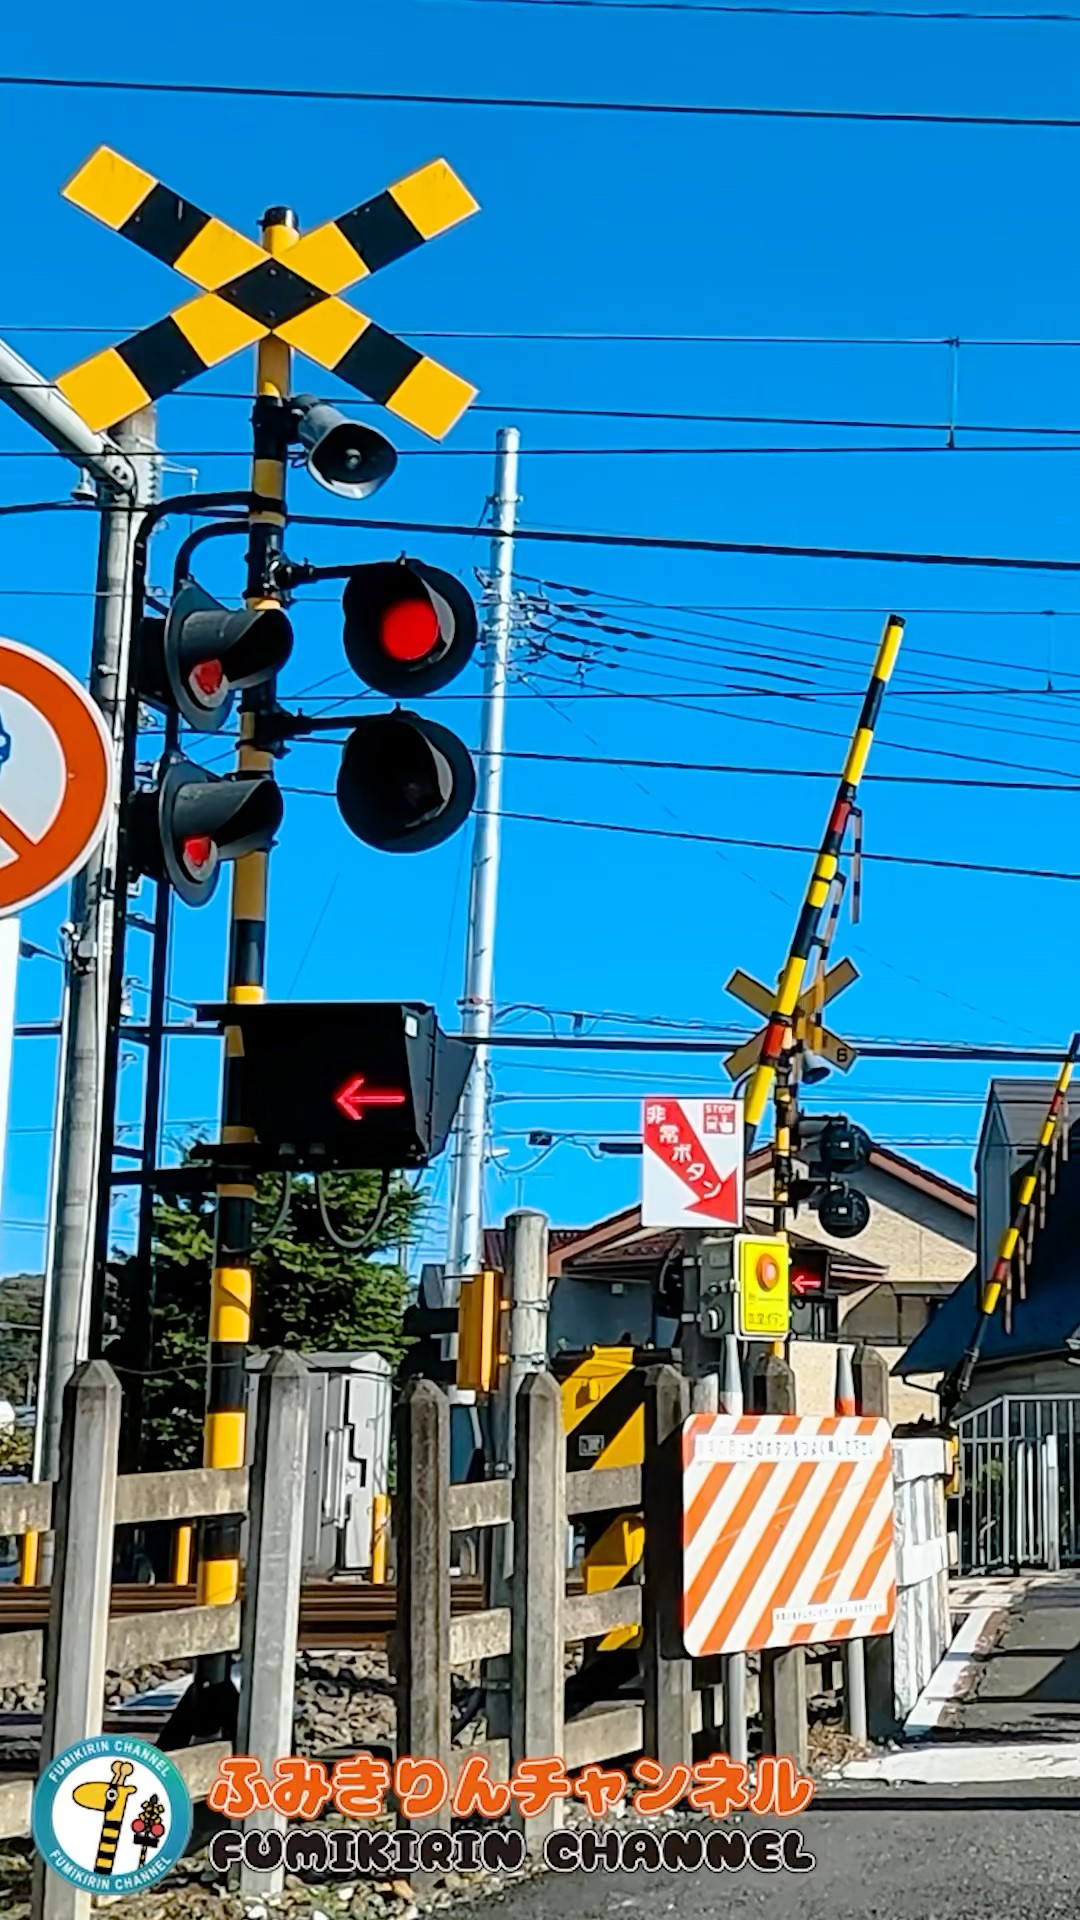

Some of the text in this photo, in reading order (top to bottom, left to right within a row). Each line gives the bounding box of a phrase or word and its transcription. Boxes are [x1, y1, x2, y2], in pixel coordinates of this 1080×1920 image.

[646, 1105, 722, 1199] 非常ボタン
